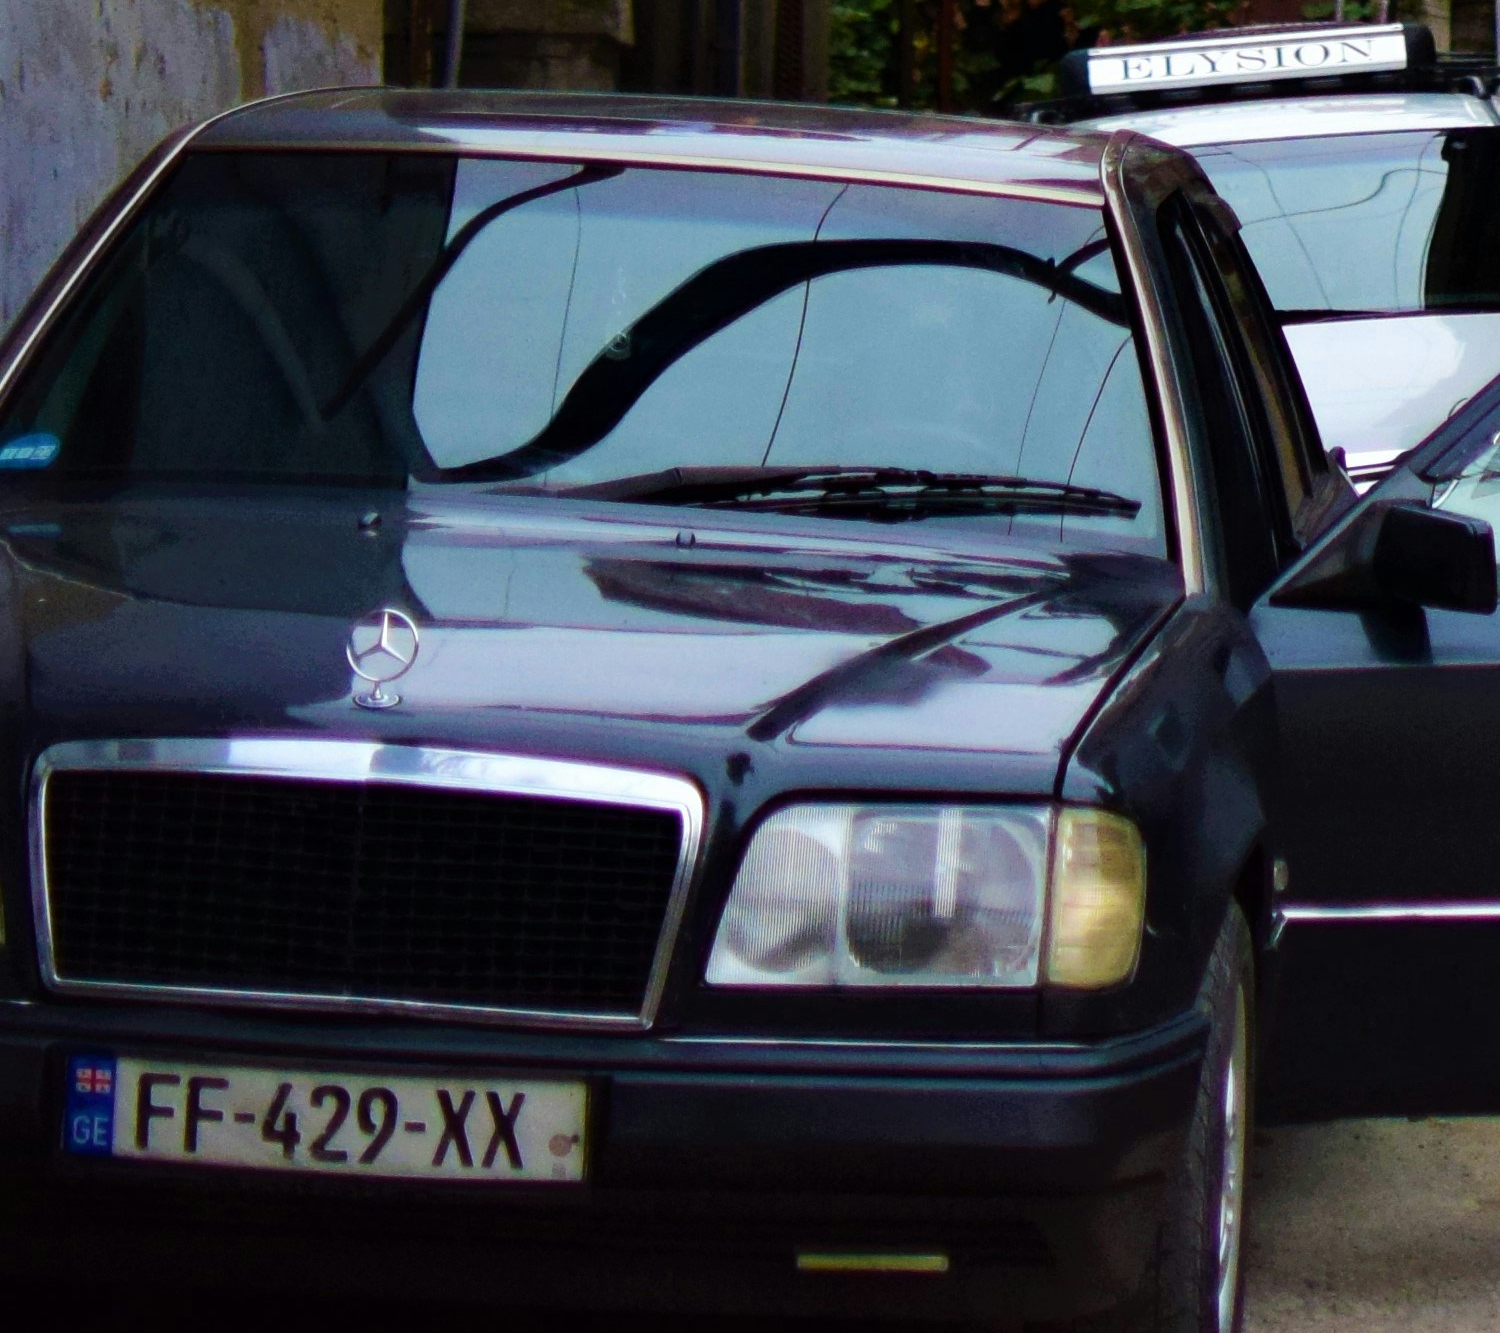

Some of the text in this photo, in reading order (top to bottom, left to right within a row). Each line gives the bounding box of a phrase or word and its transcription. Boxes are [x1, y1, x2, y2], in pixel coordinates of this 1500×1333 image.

[1121, 39, 1373, 81] ELYSION
[73, 1115, 109, 1145] GE
[136, 1072, 526, 1169] FF-429-XX
